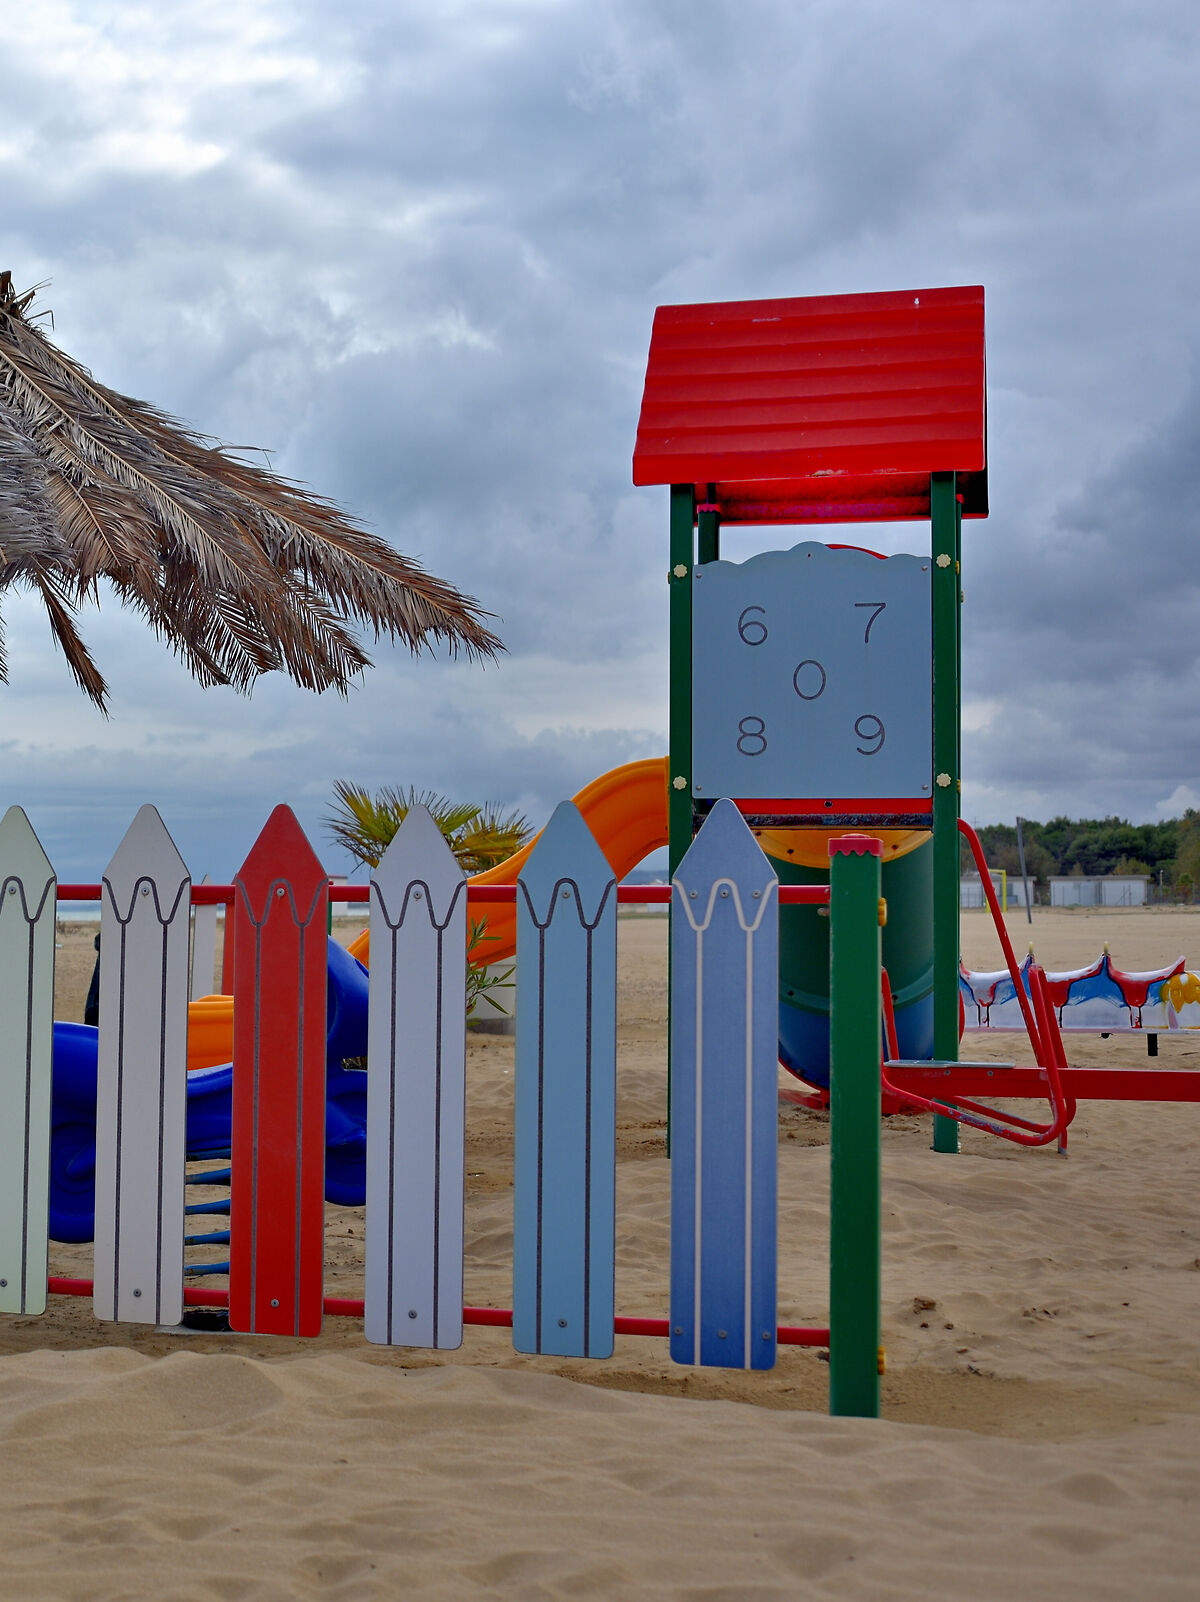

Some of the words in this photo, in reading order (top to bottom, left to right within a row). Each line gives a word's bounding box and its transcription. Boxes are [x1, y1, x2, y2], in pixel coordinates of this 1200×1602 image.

[737, 605, 768, 647] 6
[854, 602, 887, 644] 7
[792, 659, 827, 701] 0
[736, 715, 768, 757] 8
[854, 714, 886, 756] 9
